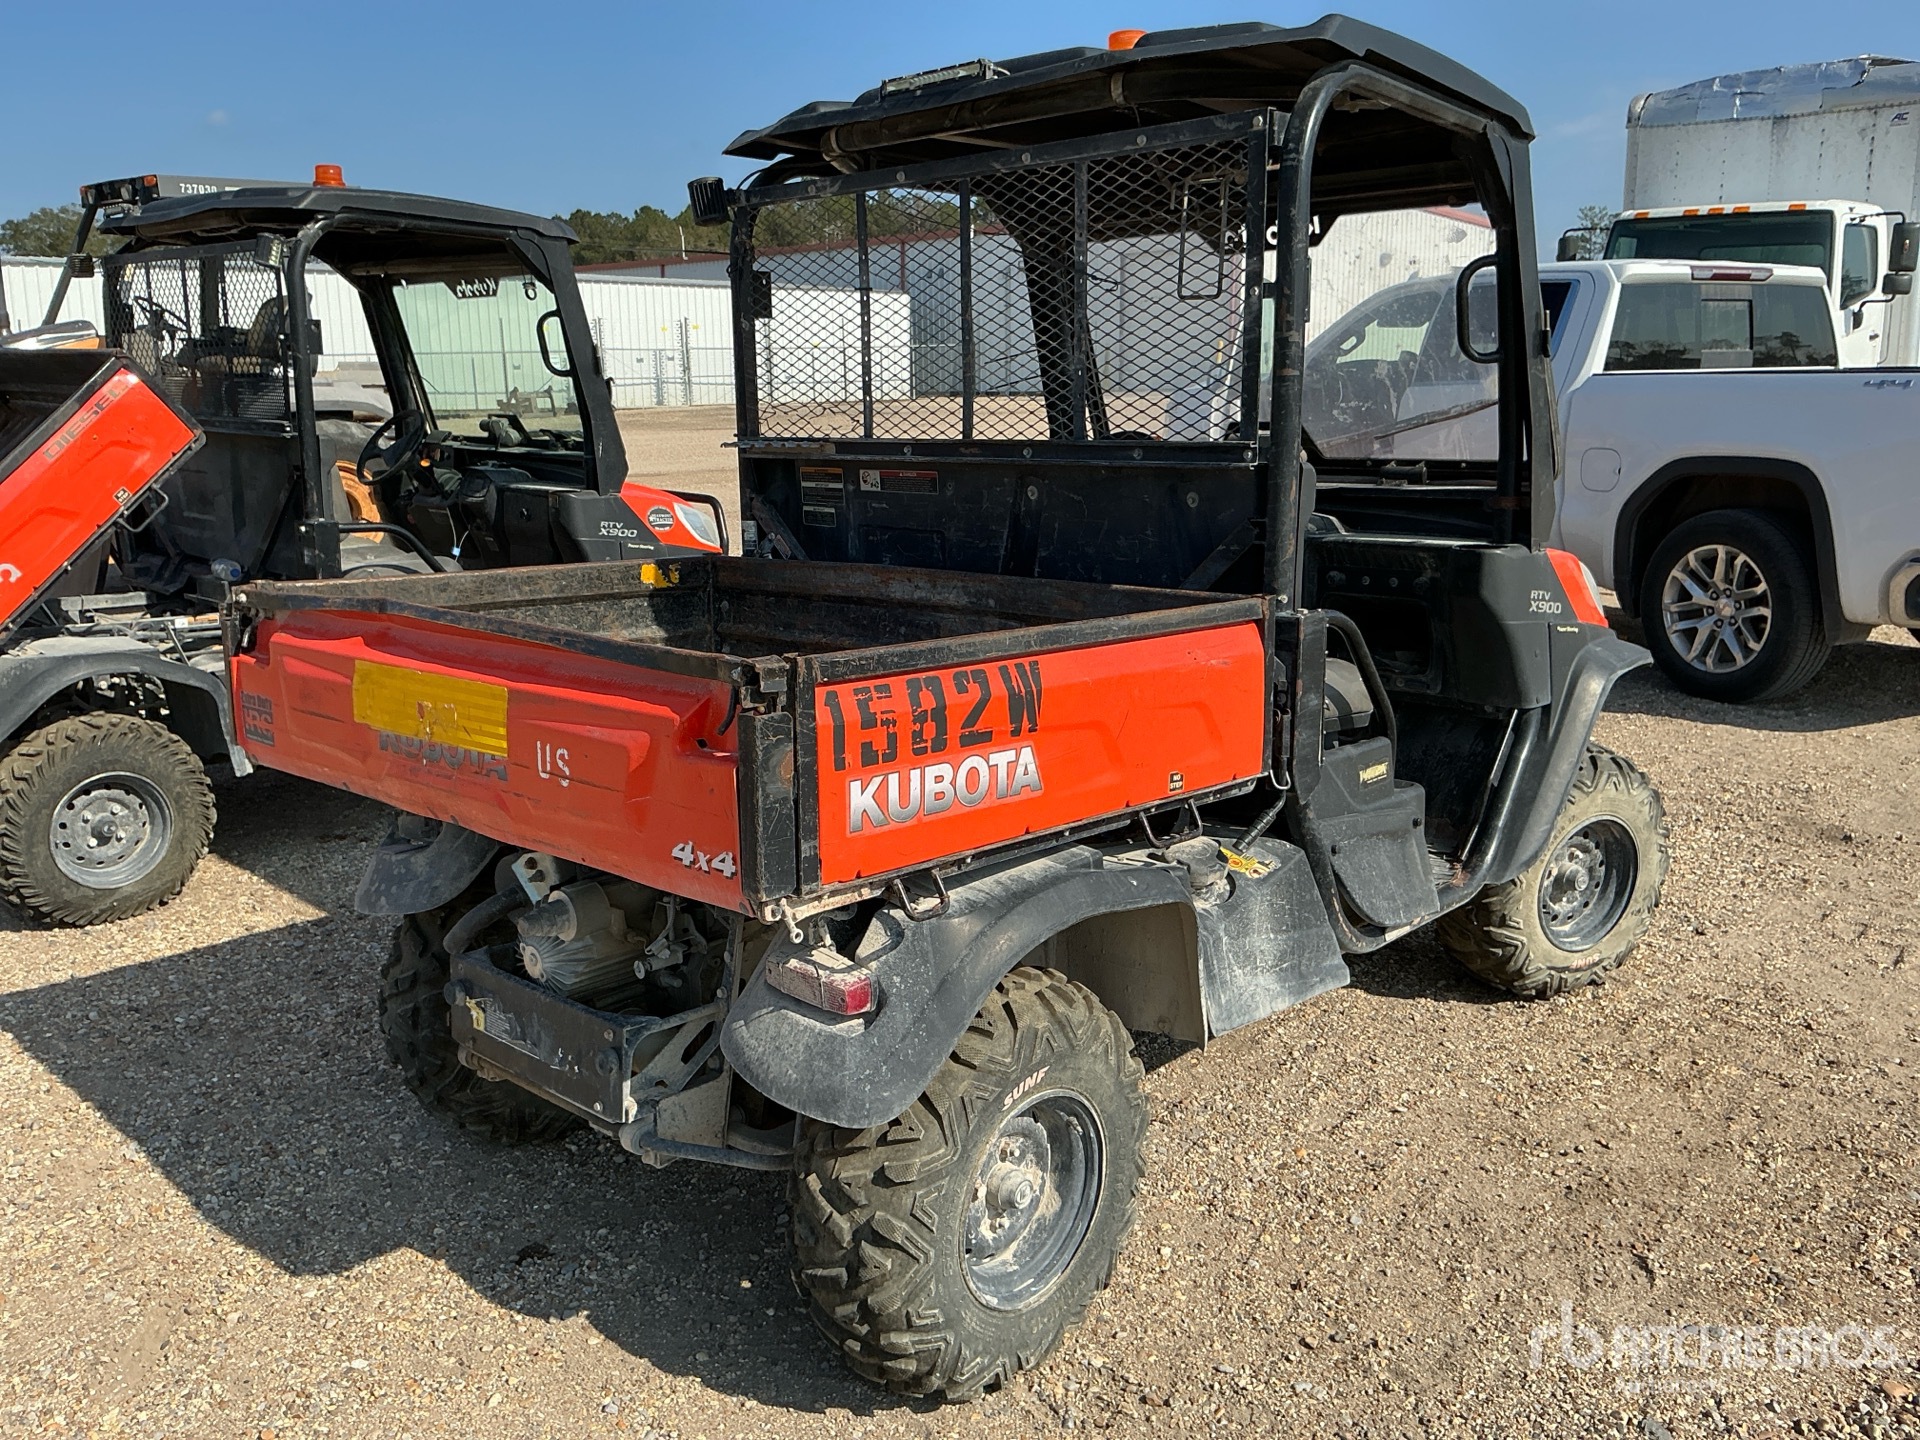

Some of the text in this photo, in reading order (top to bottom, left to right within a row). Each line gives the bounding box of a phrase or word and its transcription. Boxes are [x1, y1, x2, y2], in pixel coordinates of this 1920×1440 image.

[43, 383, 128, 459] DIESEL
[598, 528, 638, 538] X900
[600, 521, 624, 529] RTV
[1529, 600, 1562, 614] X900
[1530, 590, 1551, 600] RTV
[824, 660, 1044, 772] 1582W
[536, 740, 570, 788] US
[849, 745, 1043, 834] KUBOTA
[1170, 781, 1183, 790] STEP
[1002, 1065, 1051, 1112] SUNF
